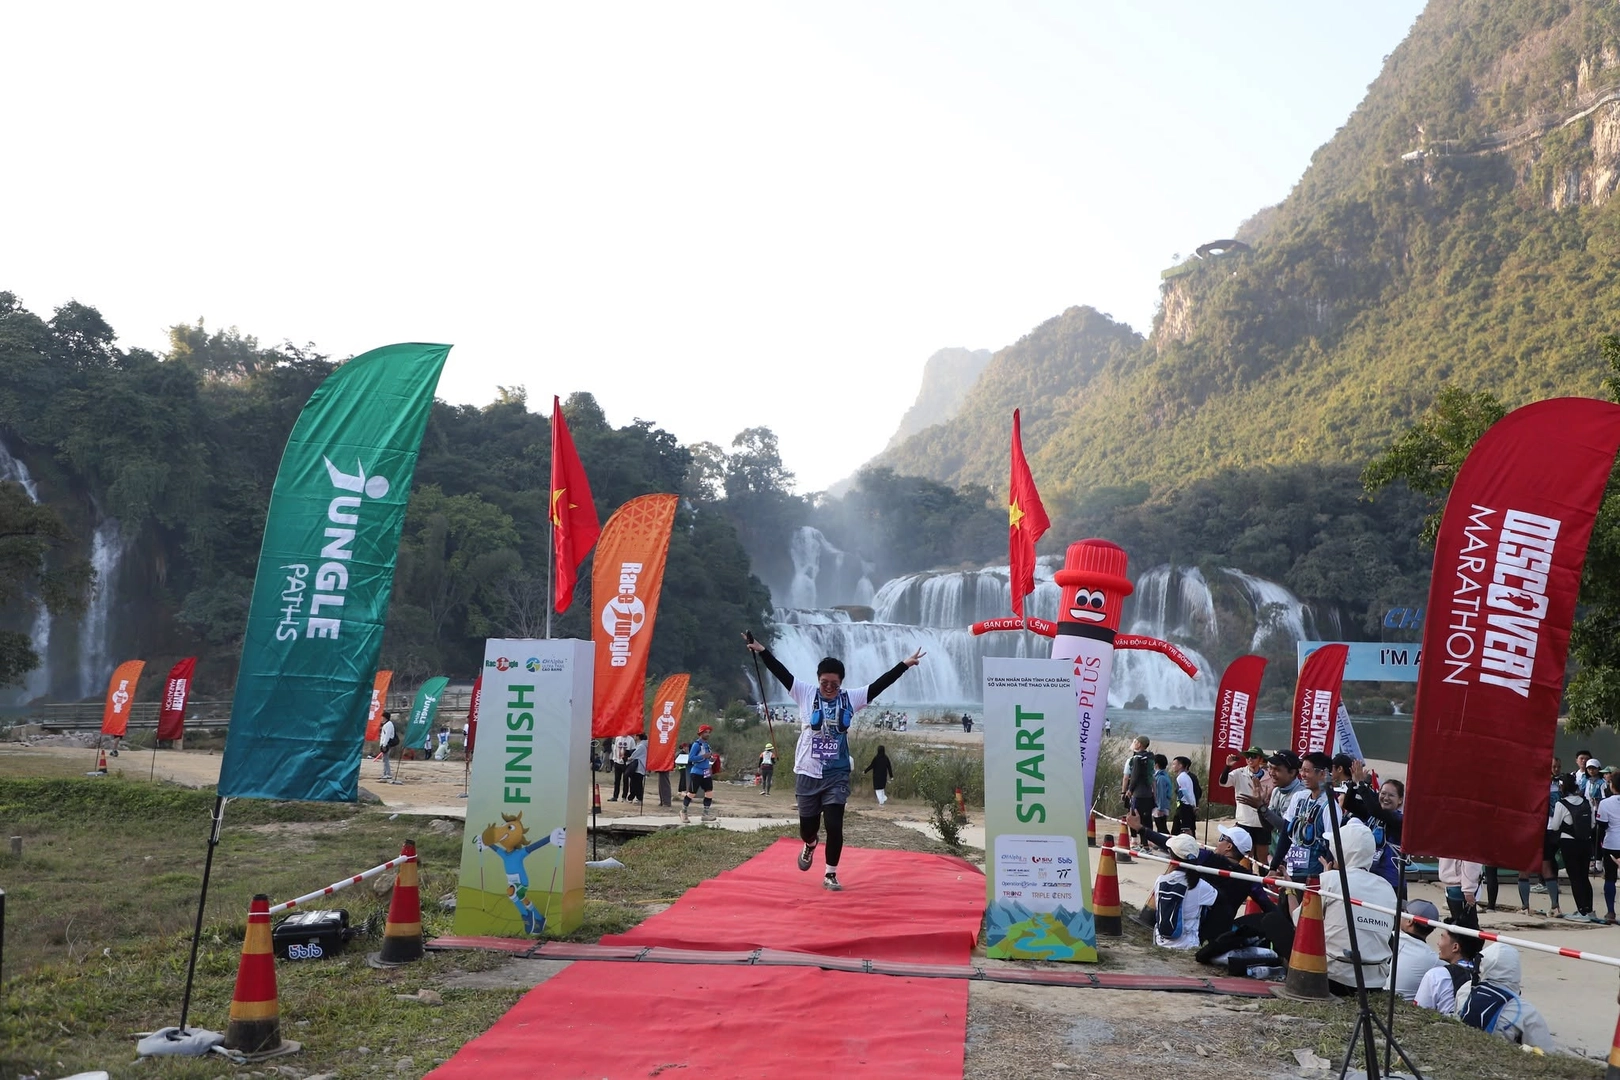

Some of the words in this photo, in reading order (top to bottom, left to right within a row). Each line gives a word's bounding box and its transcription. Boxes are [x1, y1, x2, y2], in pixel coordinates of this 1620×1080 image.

[307, 455, 389, 640] JUNGLE
[276, 564, 309, 641] PATHS
[618, 563, 643, 604] Race
[1442, 504, 1497, 686] MARATHON
[1479, 509, 1561, 698] DISCOVERY
[1079, 657, 1100, 709] PLUS
[504, 685, 535, 803] FINISH
[818, 742, 838, 750] 2420
[1218, 689, 1233, 749] MARATHON
[1298, 689, 1313, 759] MARATHON
[1015, 705, 1046, 823] START
[1292, 850, 1307, 859] 2451
[288, 943, 323, 959] 5bib
[1357, 916, 1389, 928] GARMIN
